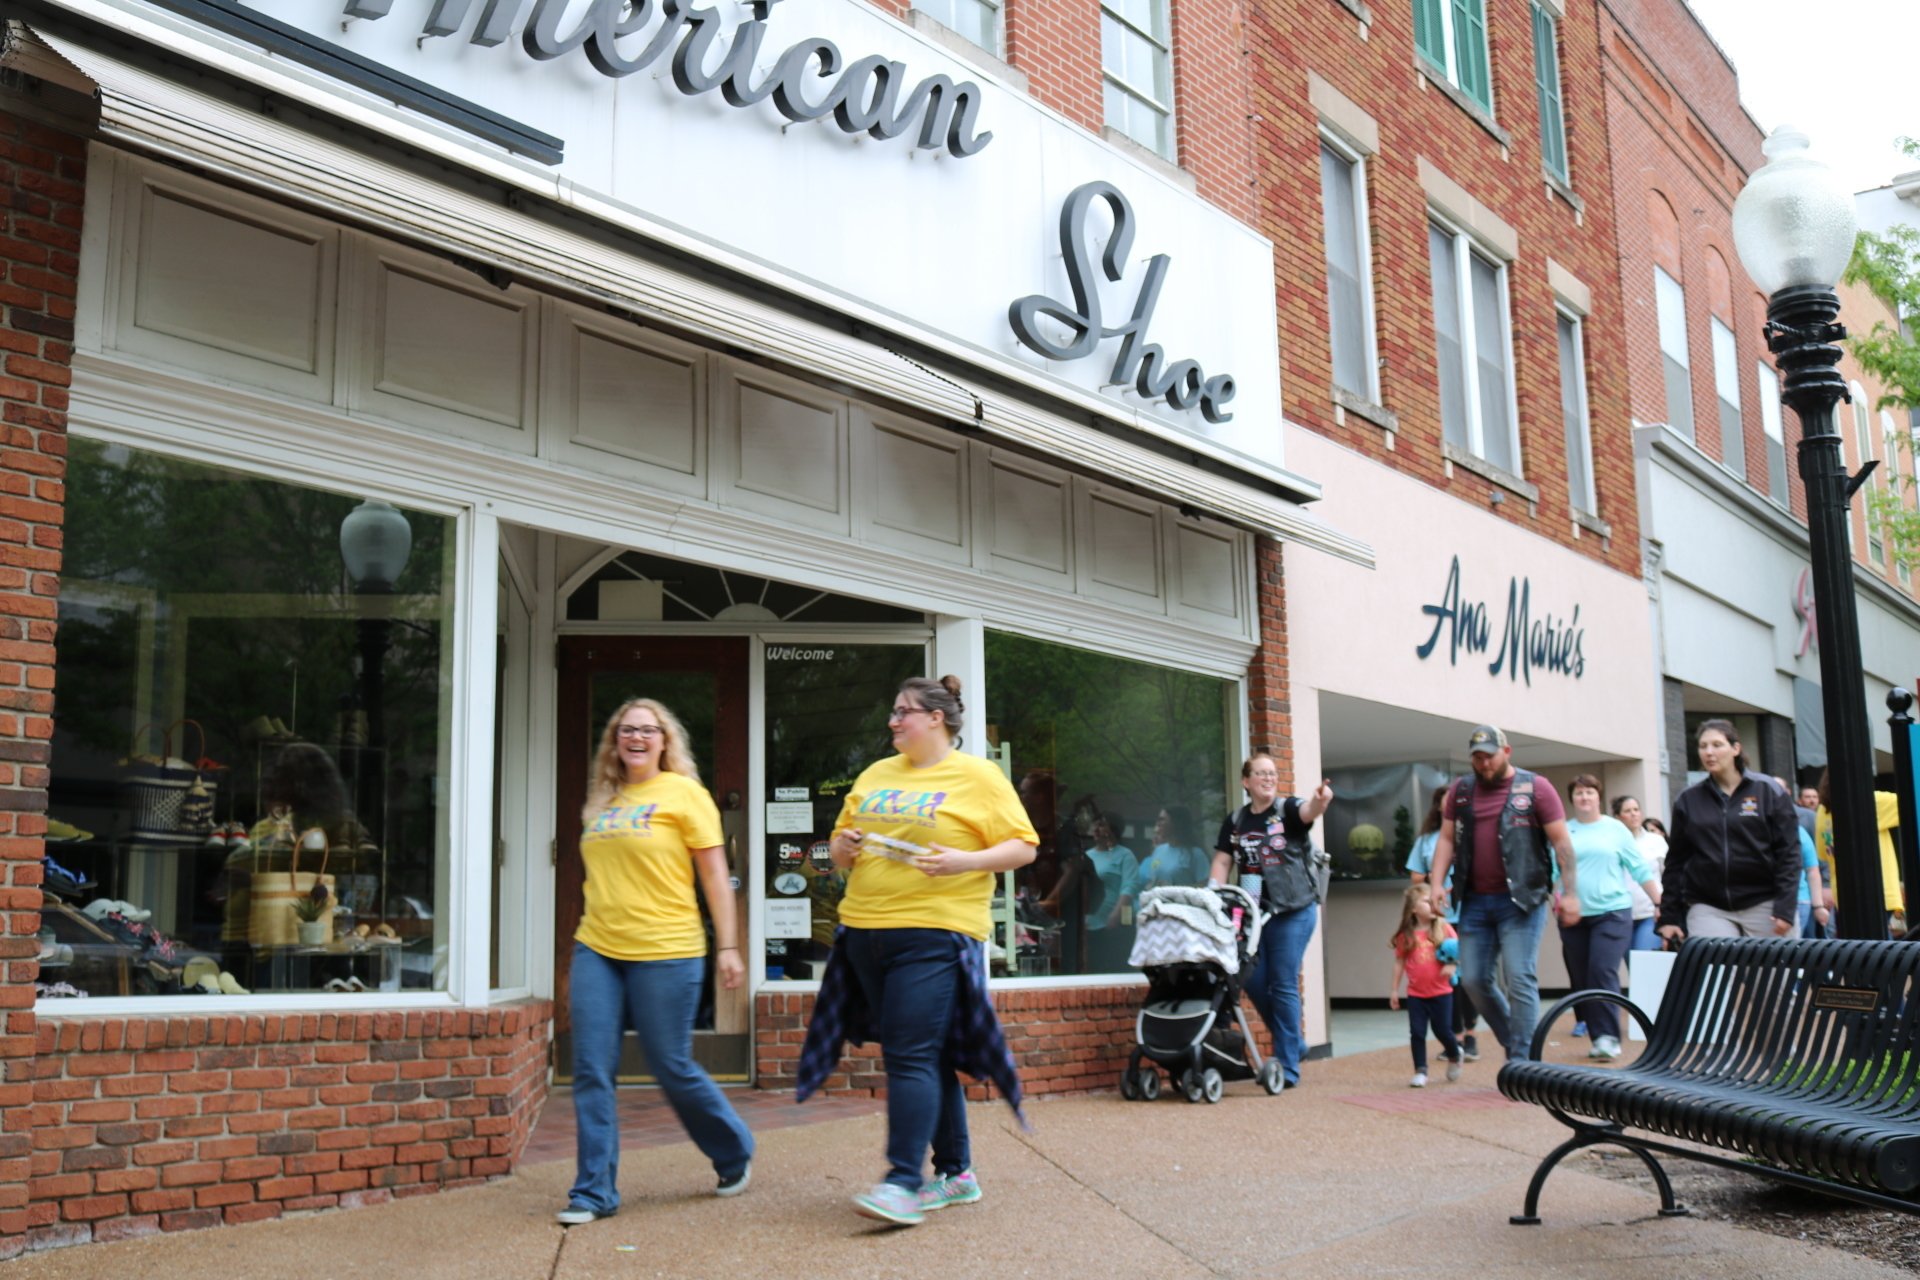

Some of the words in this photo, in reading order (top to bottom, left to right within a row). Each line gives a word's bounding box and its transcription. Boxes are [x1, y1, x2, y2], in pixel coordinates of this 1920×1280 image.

[342, 0, 993, 159] erican
[1008, 180, 1236, 424] Shoe
[767, 647, 834, 660] Welcome
[1416, 554, 1491, 667] Ana
